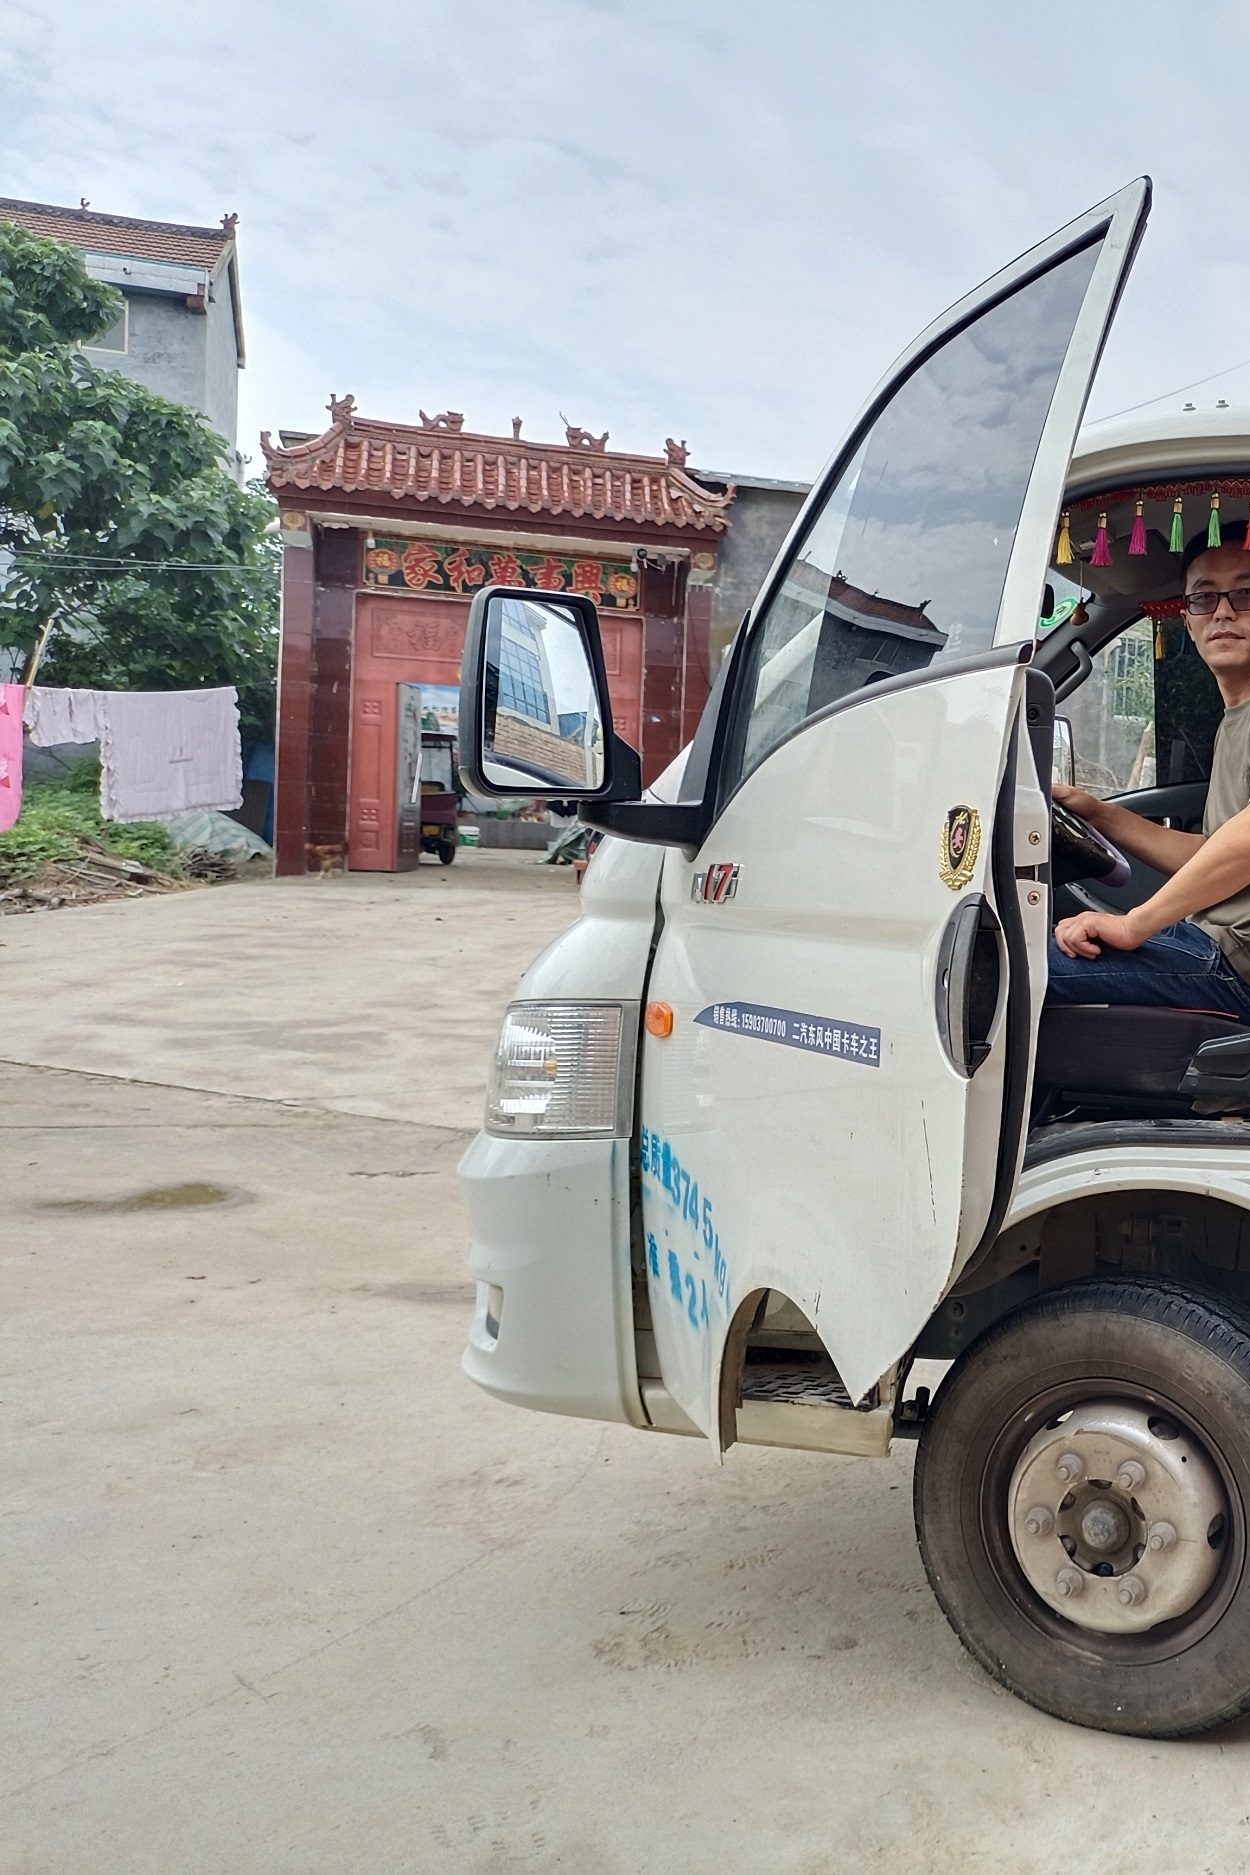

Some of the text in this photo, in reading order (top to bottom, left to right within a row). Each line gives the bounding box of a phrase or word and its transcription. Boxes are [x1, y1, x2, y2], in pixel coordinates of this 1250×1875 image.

[792, 1022, 878, 1059] 二汽东风中国卡车之王
